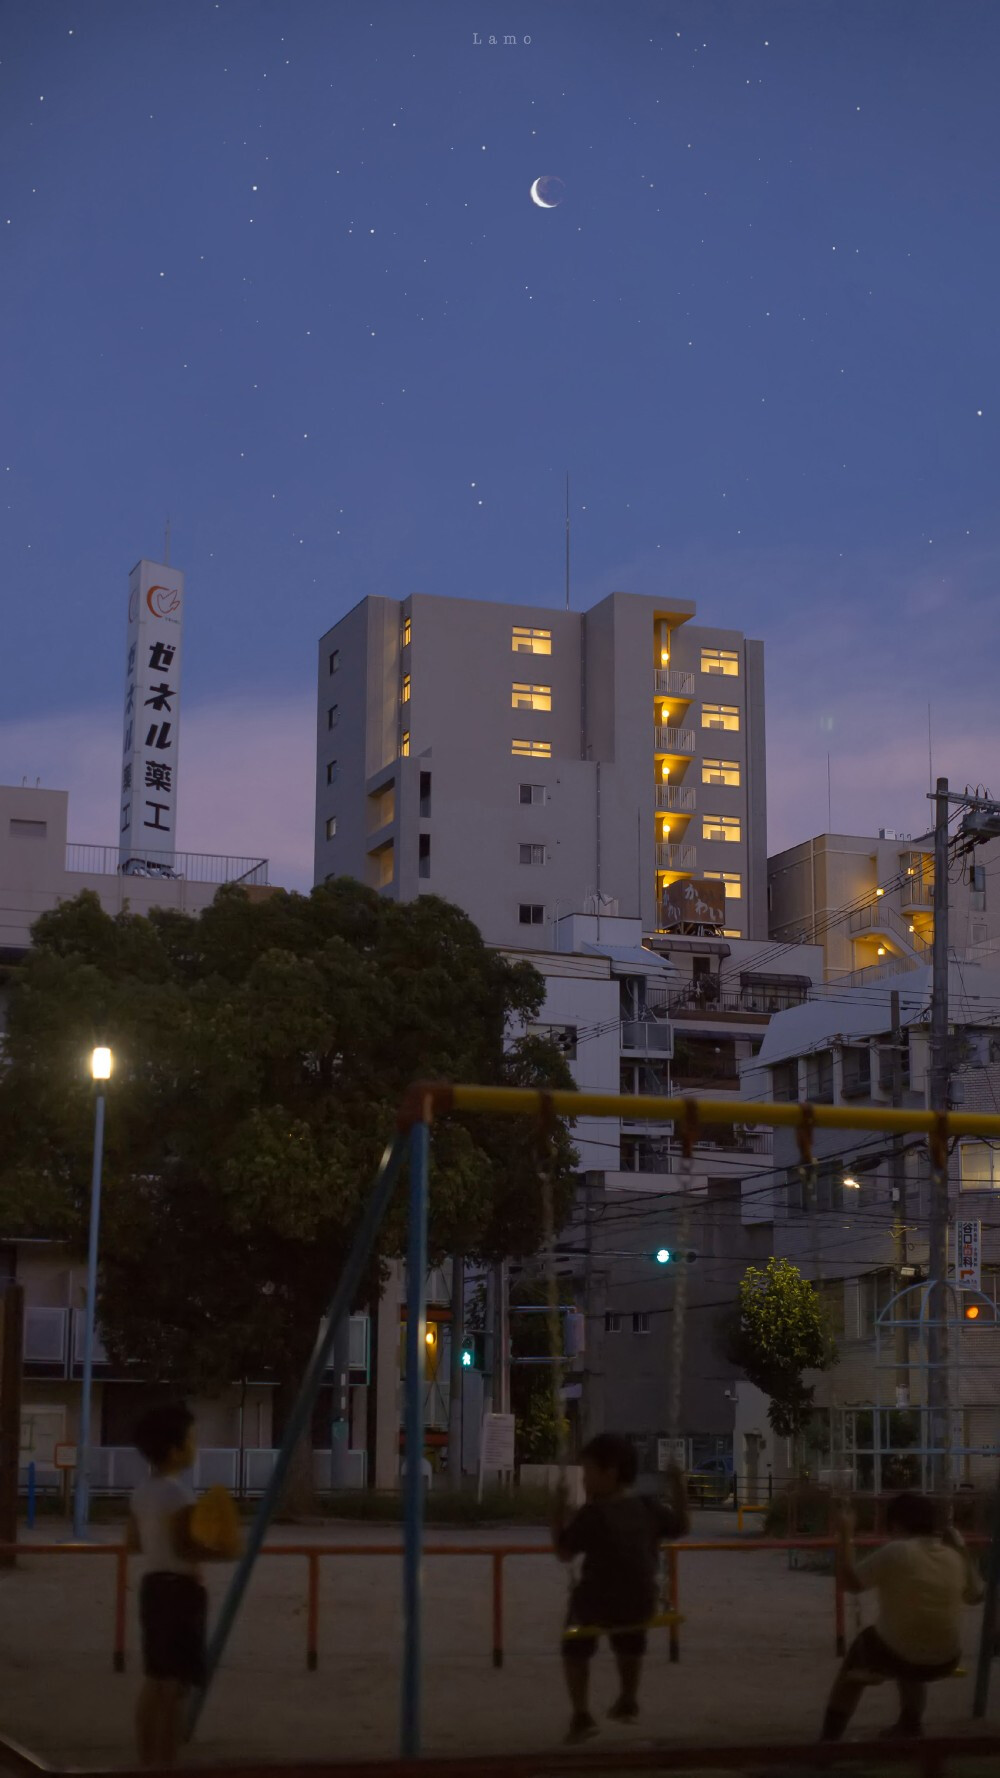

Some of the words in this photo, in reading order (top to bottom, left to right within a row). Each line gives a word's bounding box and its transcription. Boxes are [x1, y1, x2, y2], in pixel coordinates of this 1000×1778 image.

[144, 641, 177, 832] ゼネル薬工
[963, 1222, 973, 1267] 谷口歯科
